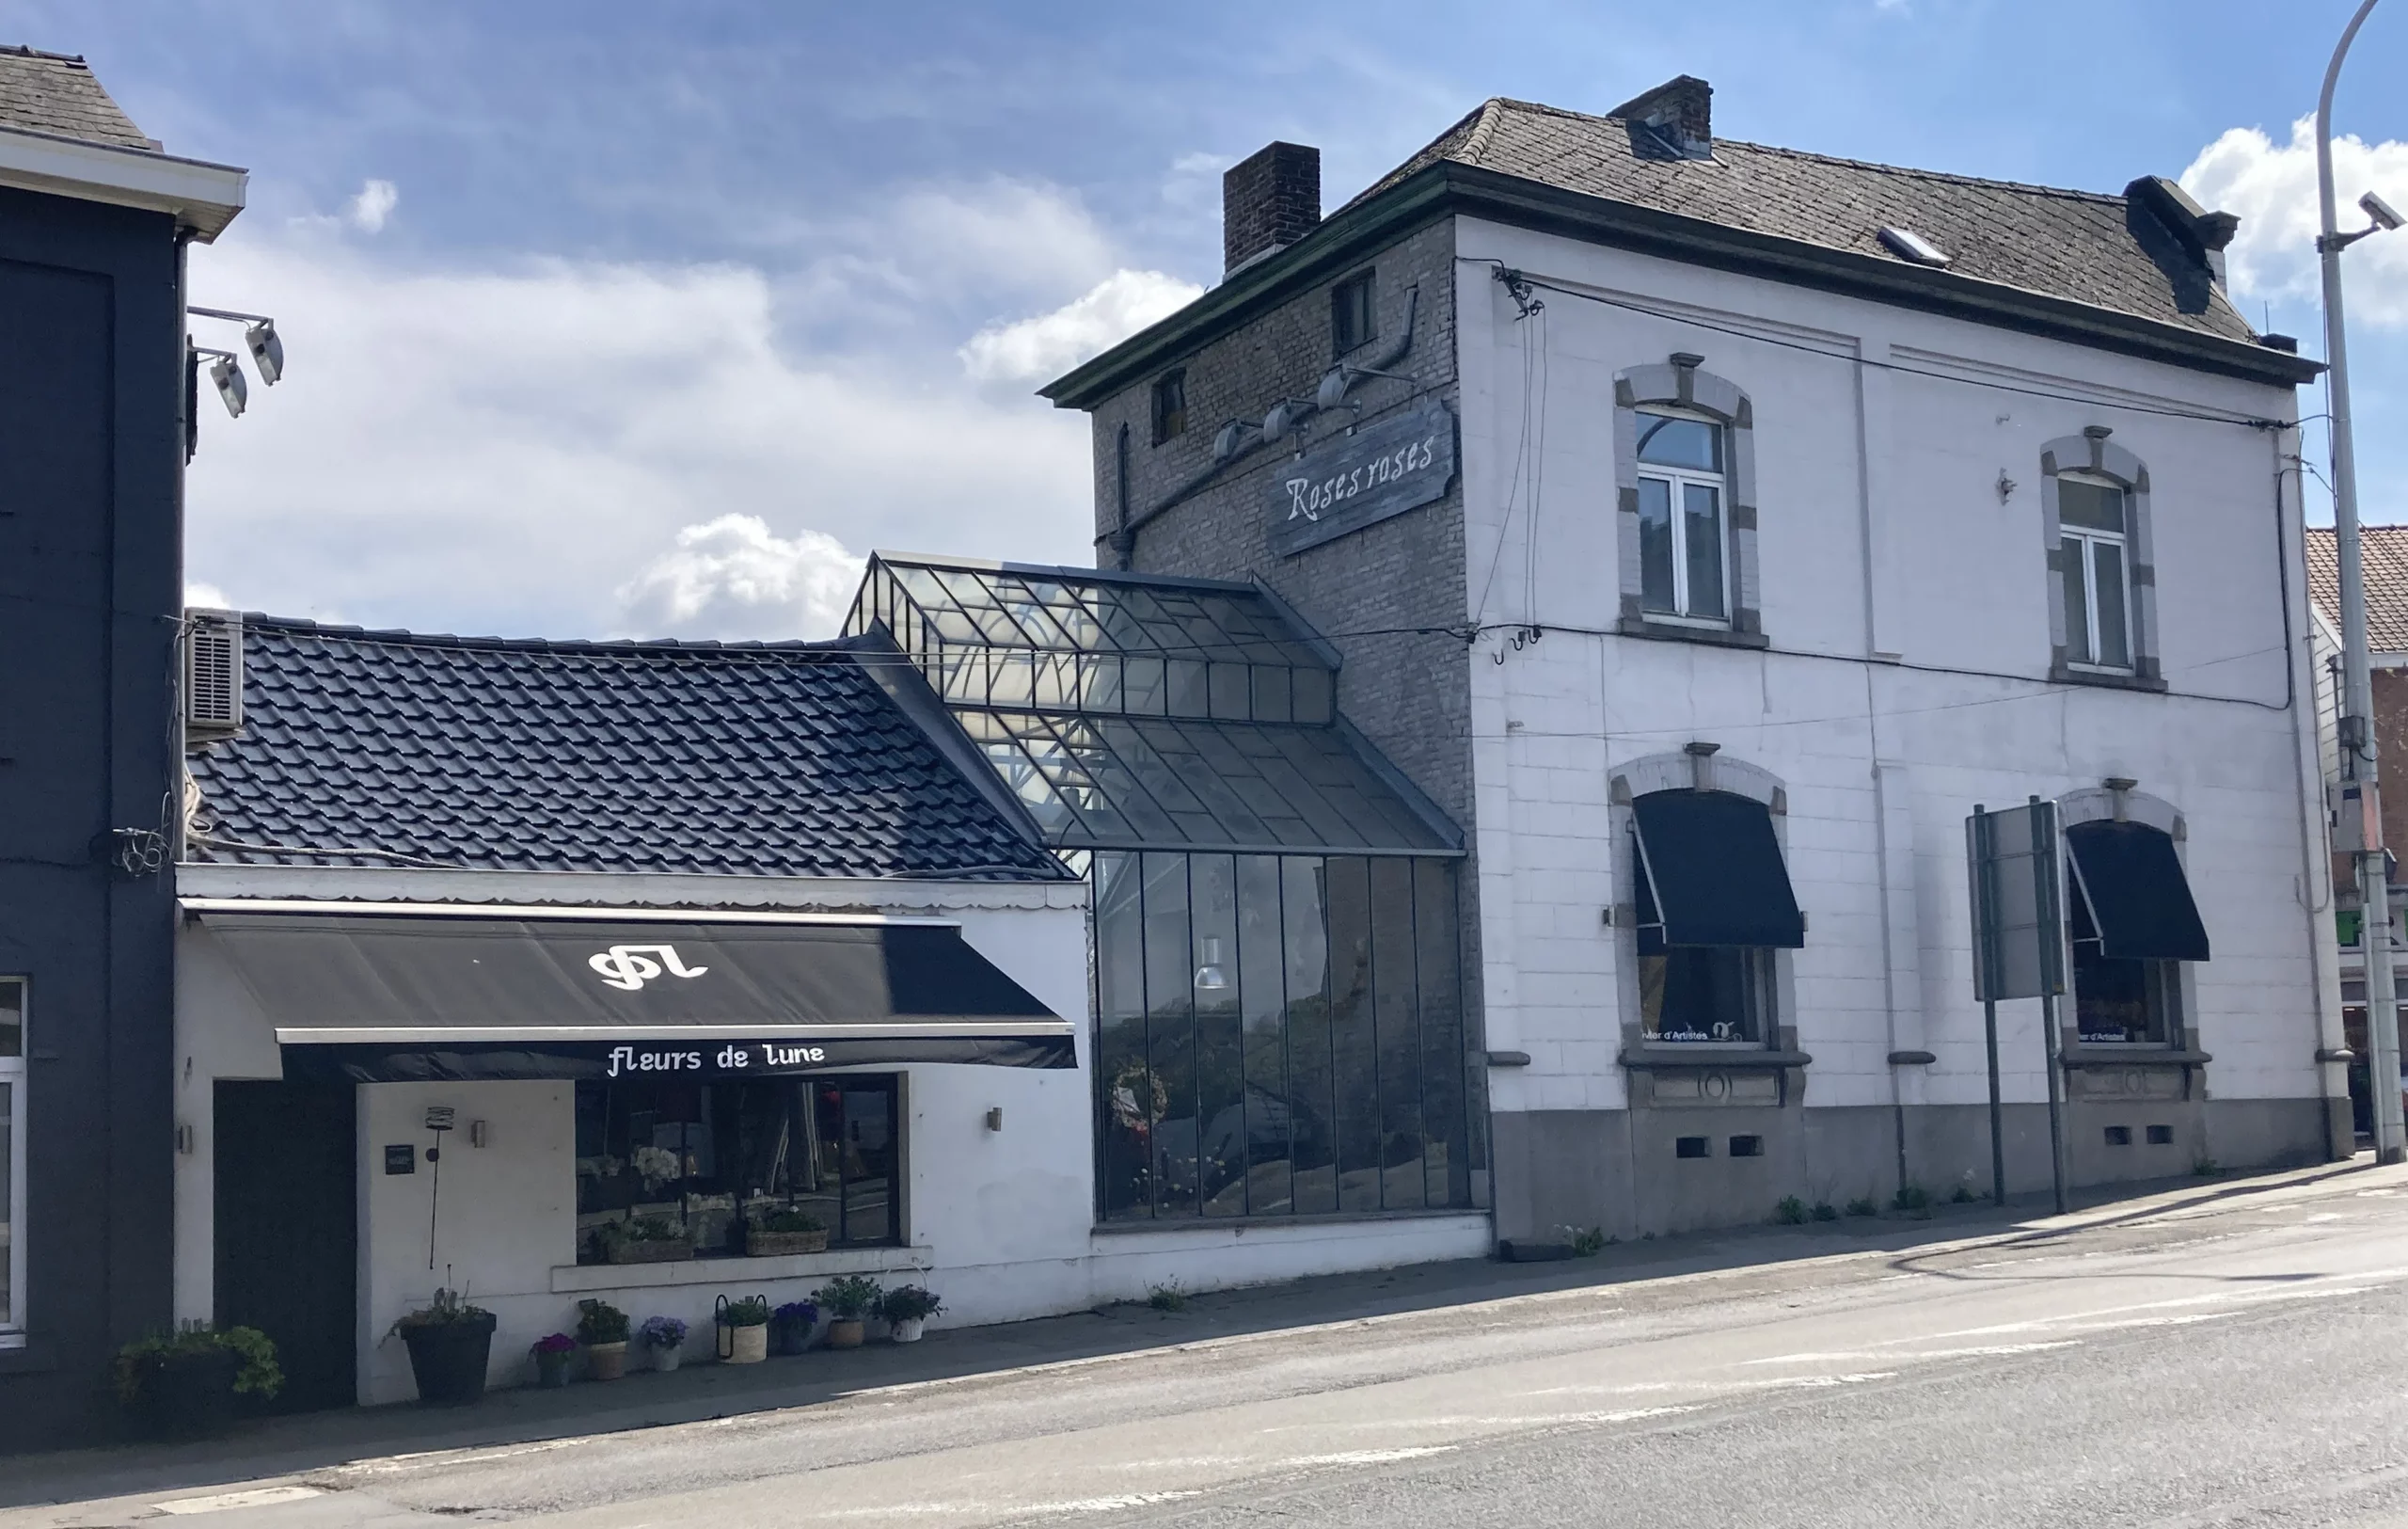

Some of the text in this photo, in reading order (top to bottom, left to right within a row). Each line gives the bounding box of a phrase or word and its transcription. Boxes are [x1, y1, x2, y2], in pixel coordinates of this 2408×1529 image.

[1286, 436, 1434, 520] Roses roses
[607, 1043, 825, 1076] fleurs de lune
